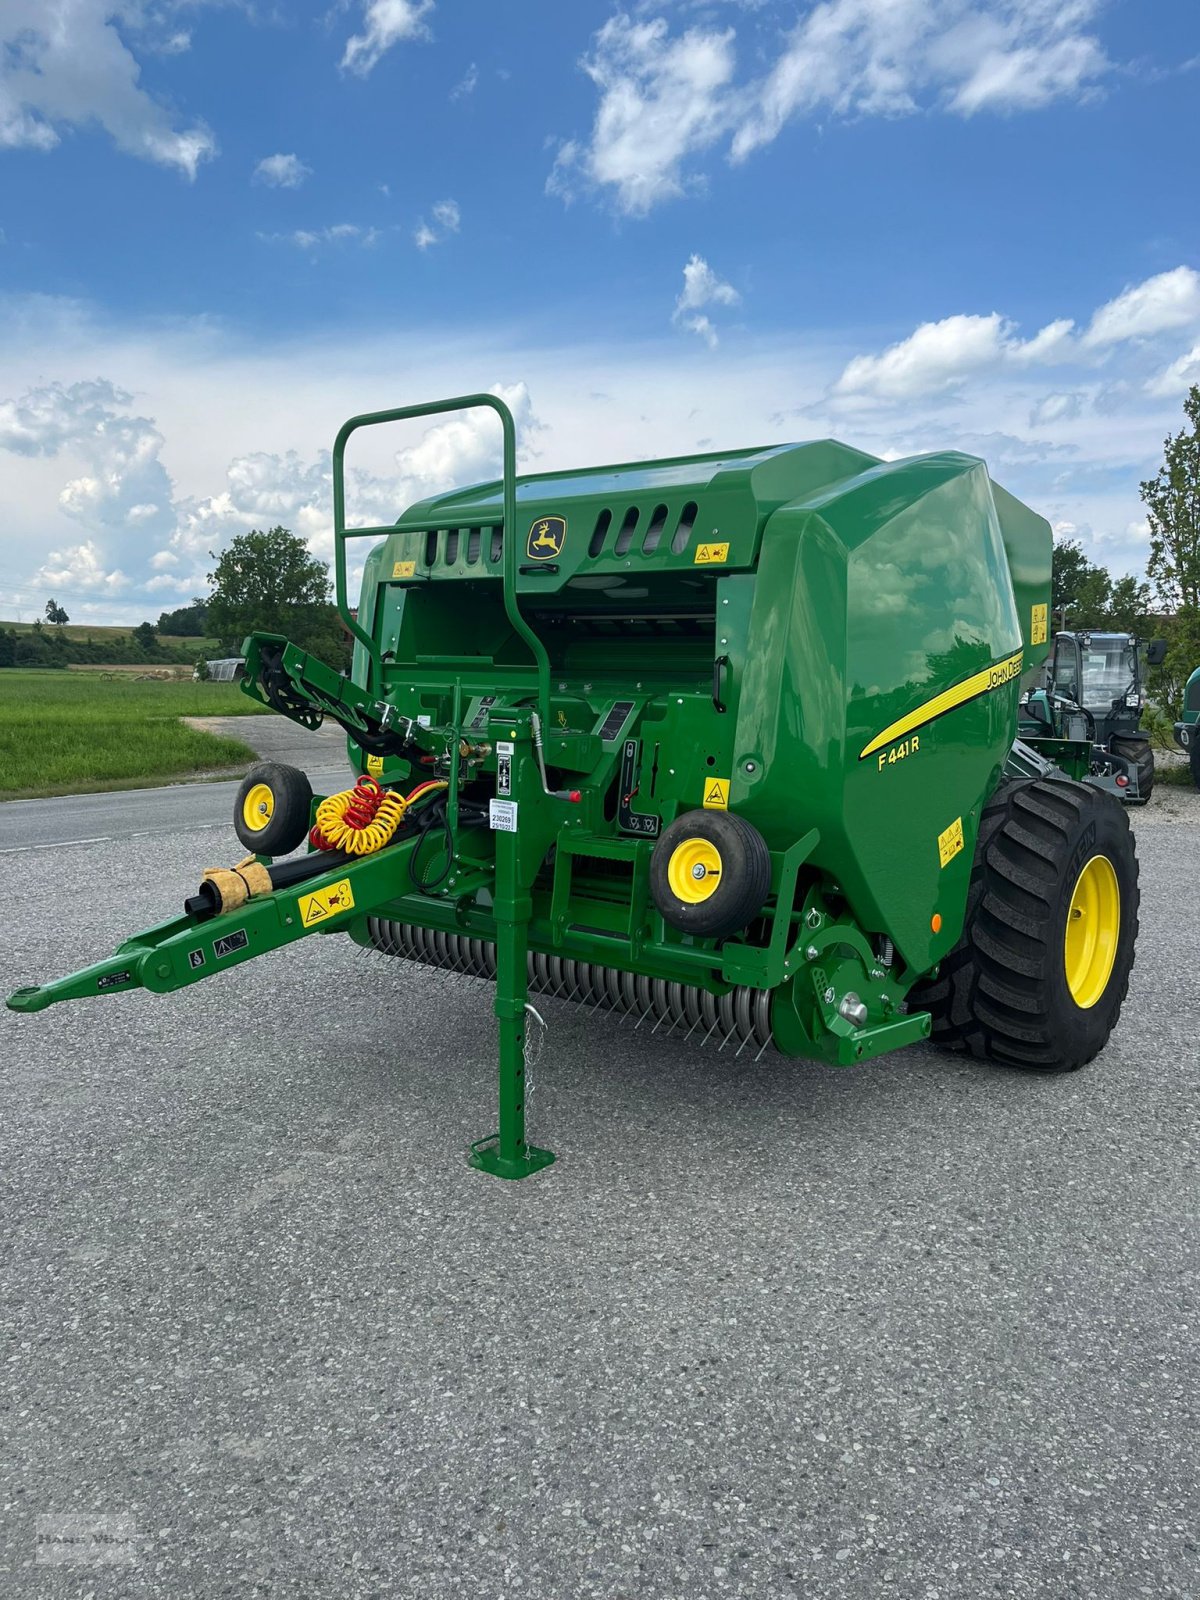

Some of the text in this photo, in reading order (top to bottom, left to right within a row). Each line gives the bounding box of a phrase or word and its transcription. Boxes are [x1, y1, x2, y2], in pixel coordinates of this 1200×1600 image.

[987, 667, 1008, 688] JOHN
[878, 736, 920, 771] F 441 R
